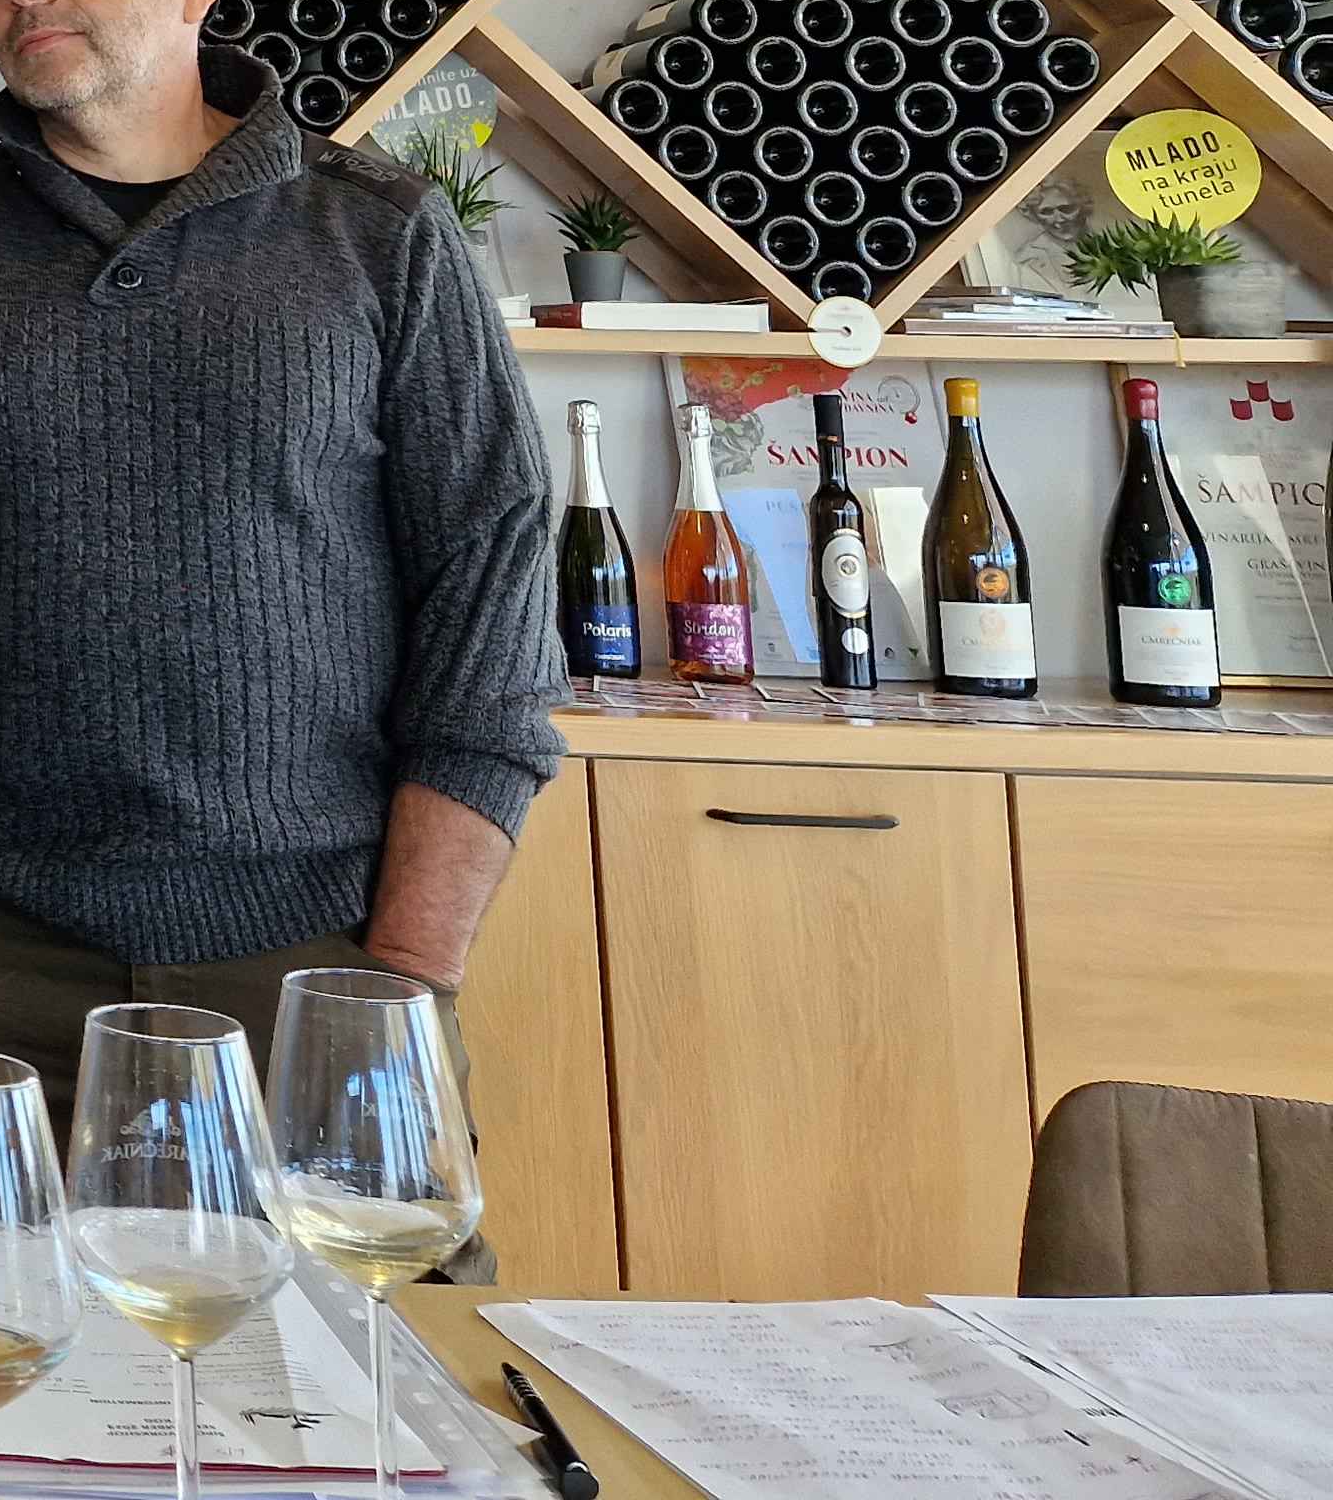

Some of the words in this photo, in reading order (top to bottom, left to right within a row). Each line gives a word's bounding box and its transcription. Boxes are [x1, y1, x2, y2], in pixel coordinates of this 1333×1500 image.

[1141, 175, 1170, 192] na
[1173, 157, 1238, 186] kraju
[1158, 179, 1235, 208] tunela
[1198, 472, 1326, 508] ŠAMPIO
[583, 621, 632, 638] Polaris
